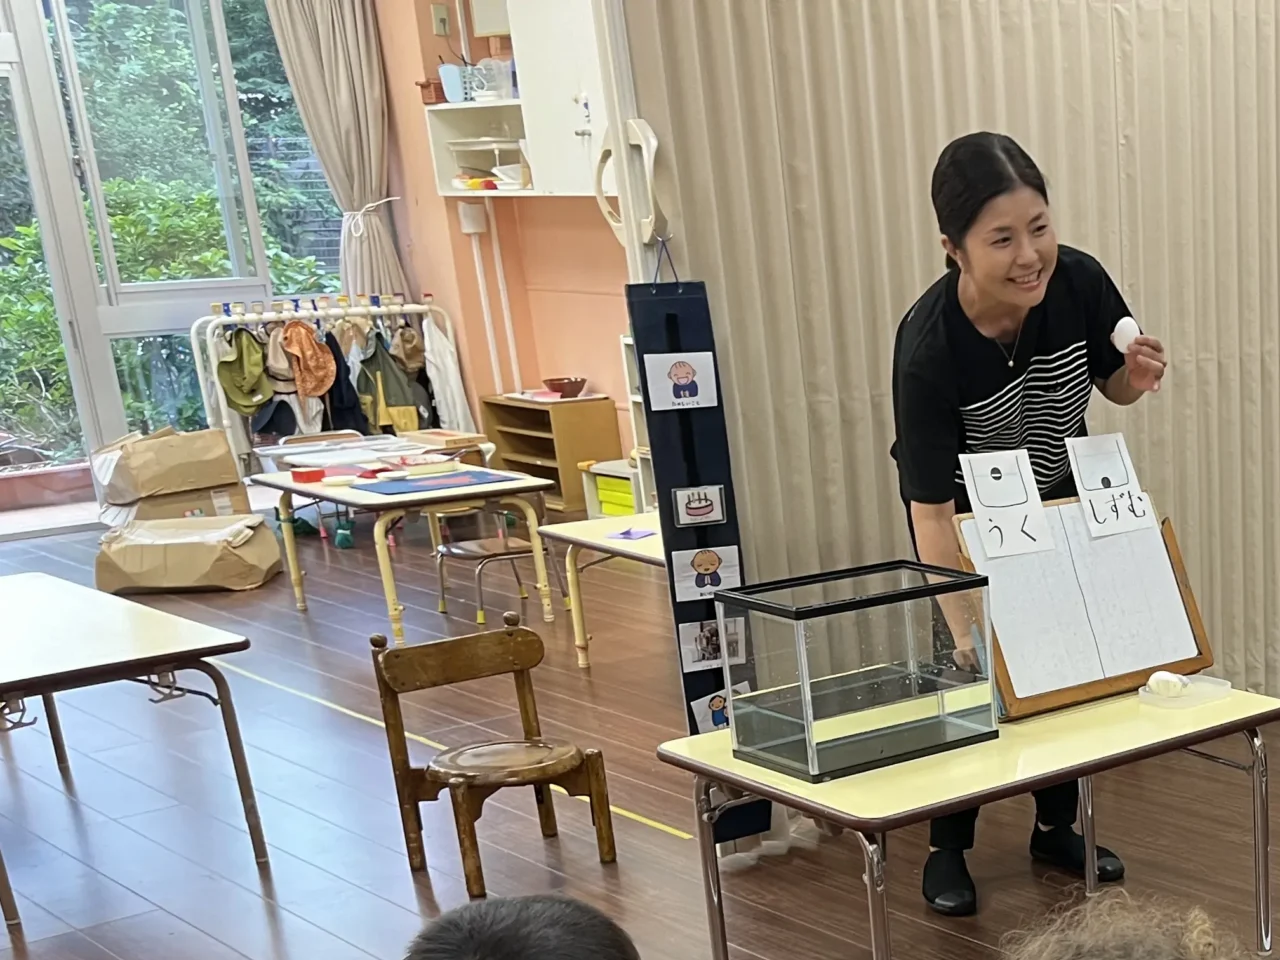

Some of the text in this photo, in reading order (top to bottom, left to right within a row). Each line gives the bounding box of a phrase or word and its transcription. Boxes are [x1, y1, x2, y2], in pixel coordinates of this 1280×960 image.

[1089, 490, 1146, 524] しずむ
[988, 514, 1037, 548] うく
